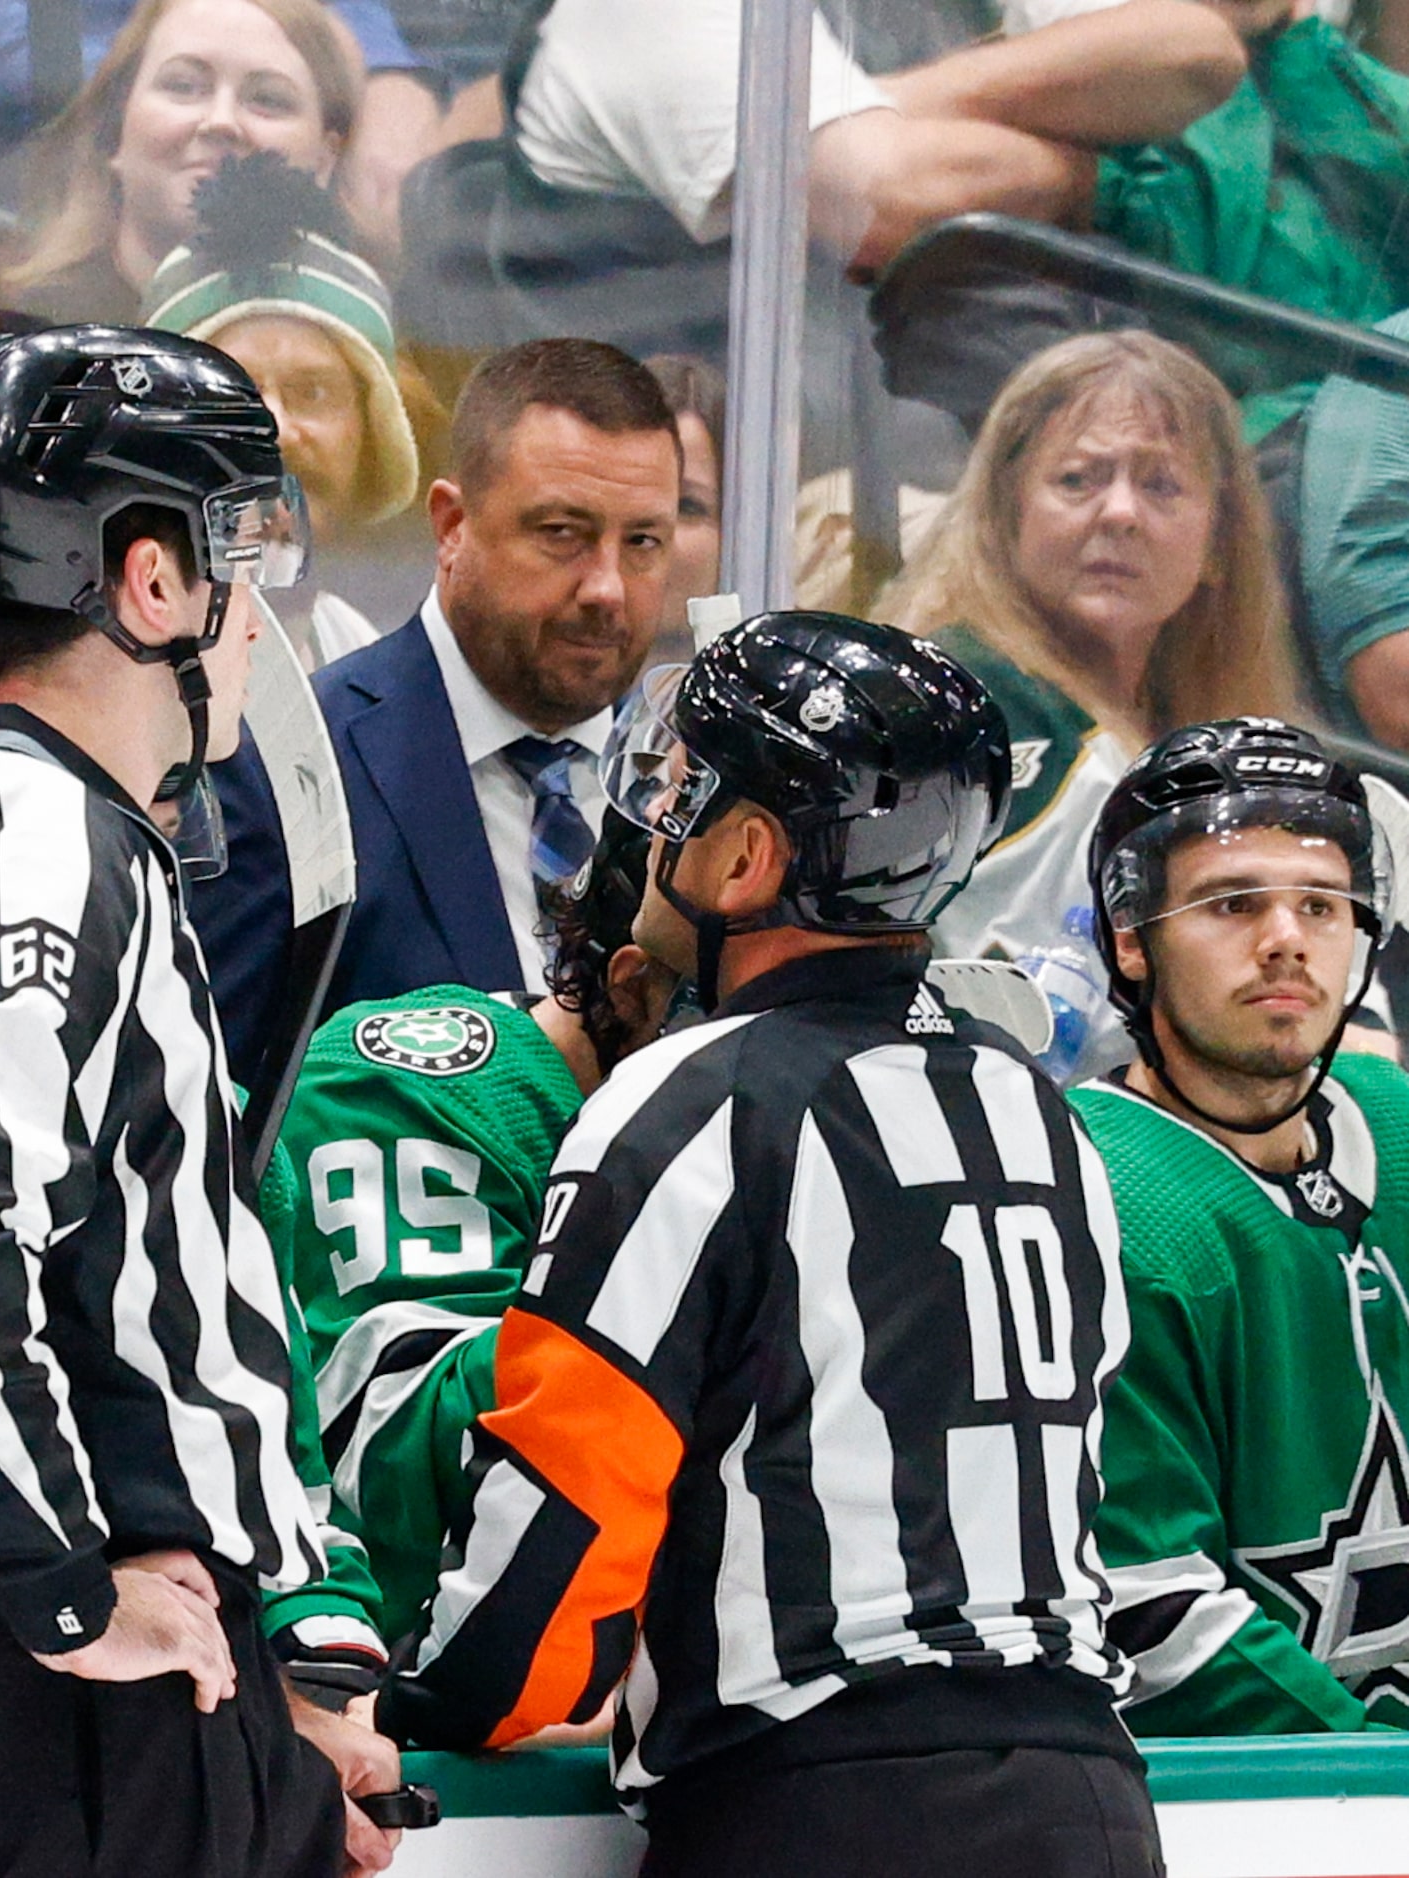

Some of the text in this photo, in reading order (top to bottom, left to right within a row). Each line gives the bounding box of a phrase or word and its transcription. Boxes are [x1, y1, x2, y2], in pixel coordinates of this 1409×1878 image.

[1235, 755, 1326, 777] CCM
[904, 1014, 955, 1035] adidas
[364, 1028, 452, 1070] STARS
[307, 1137, 493, 1297] 95
[939, 1204, 1078, 1401] 10
